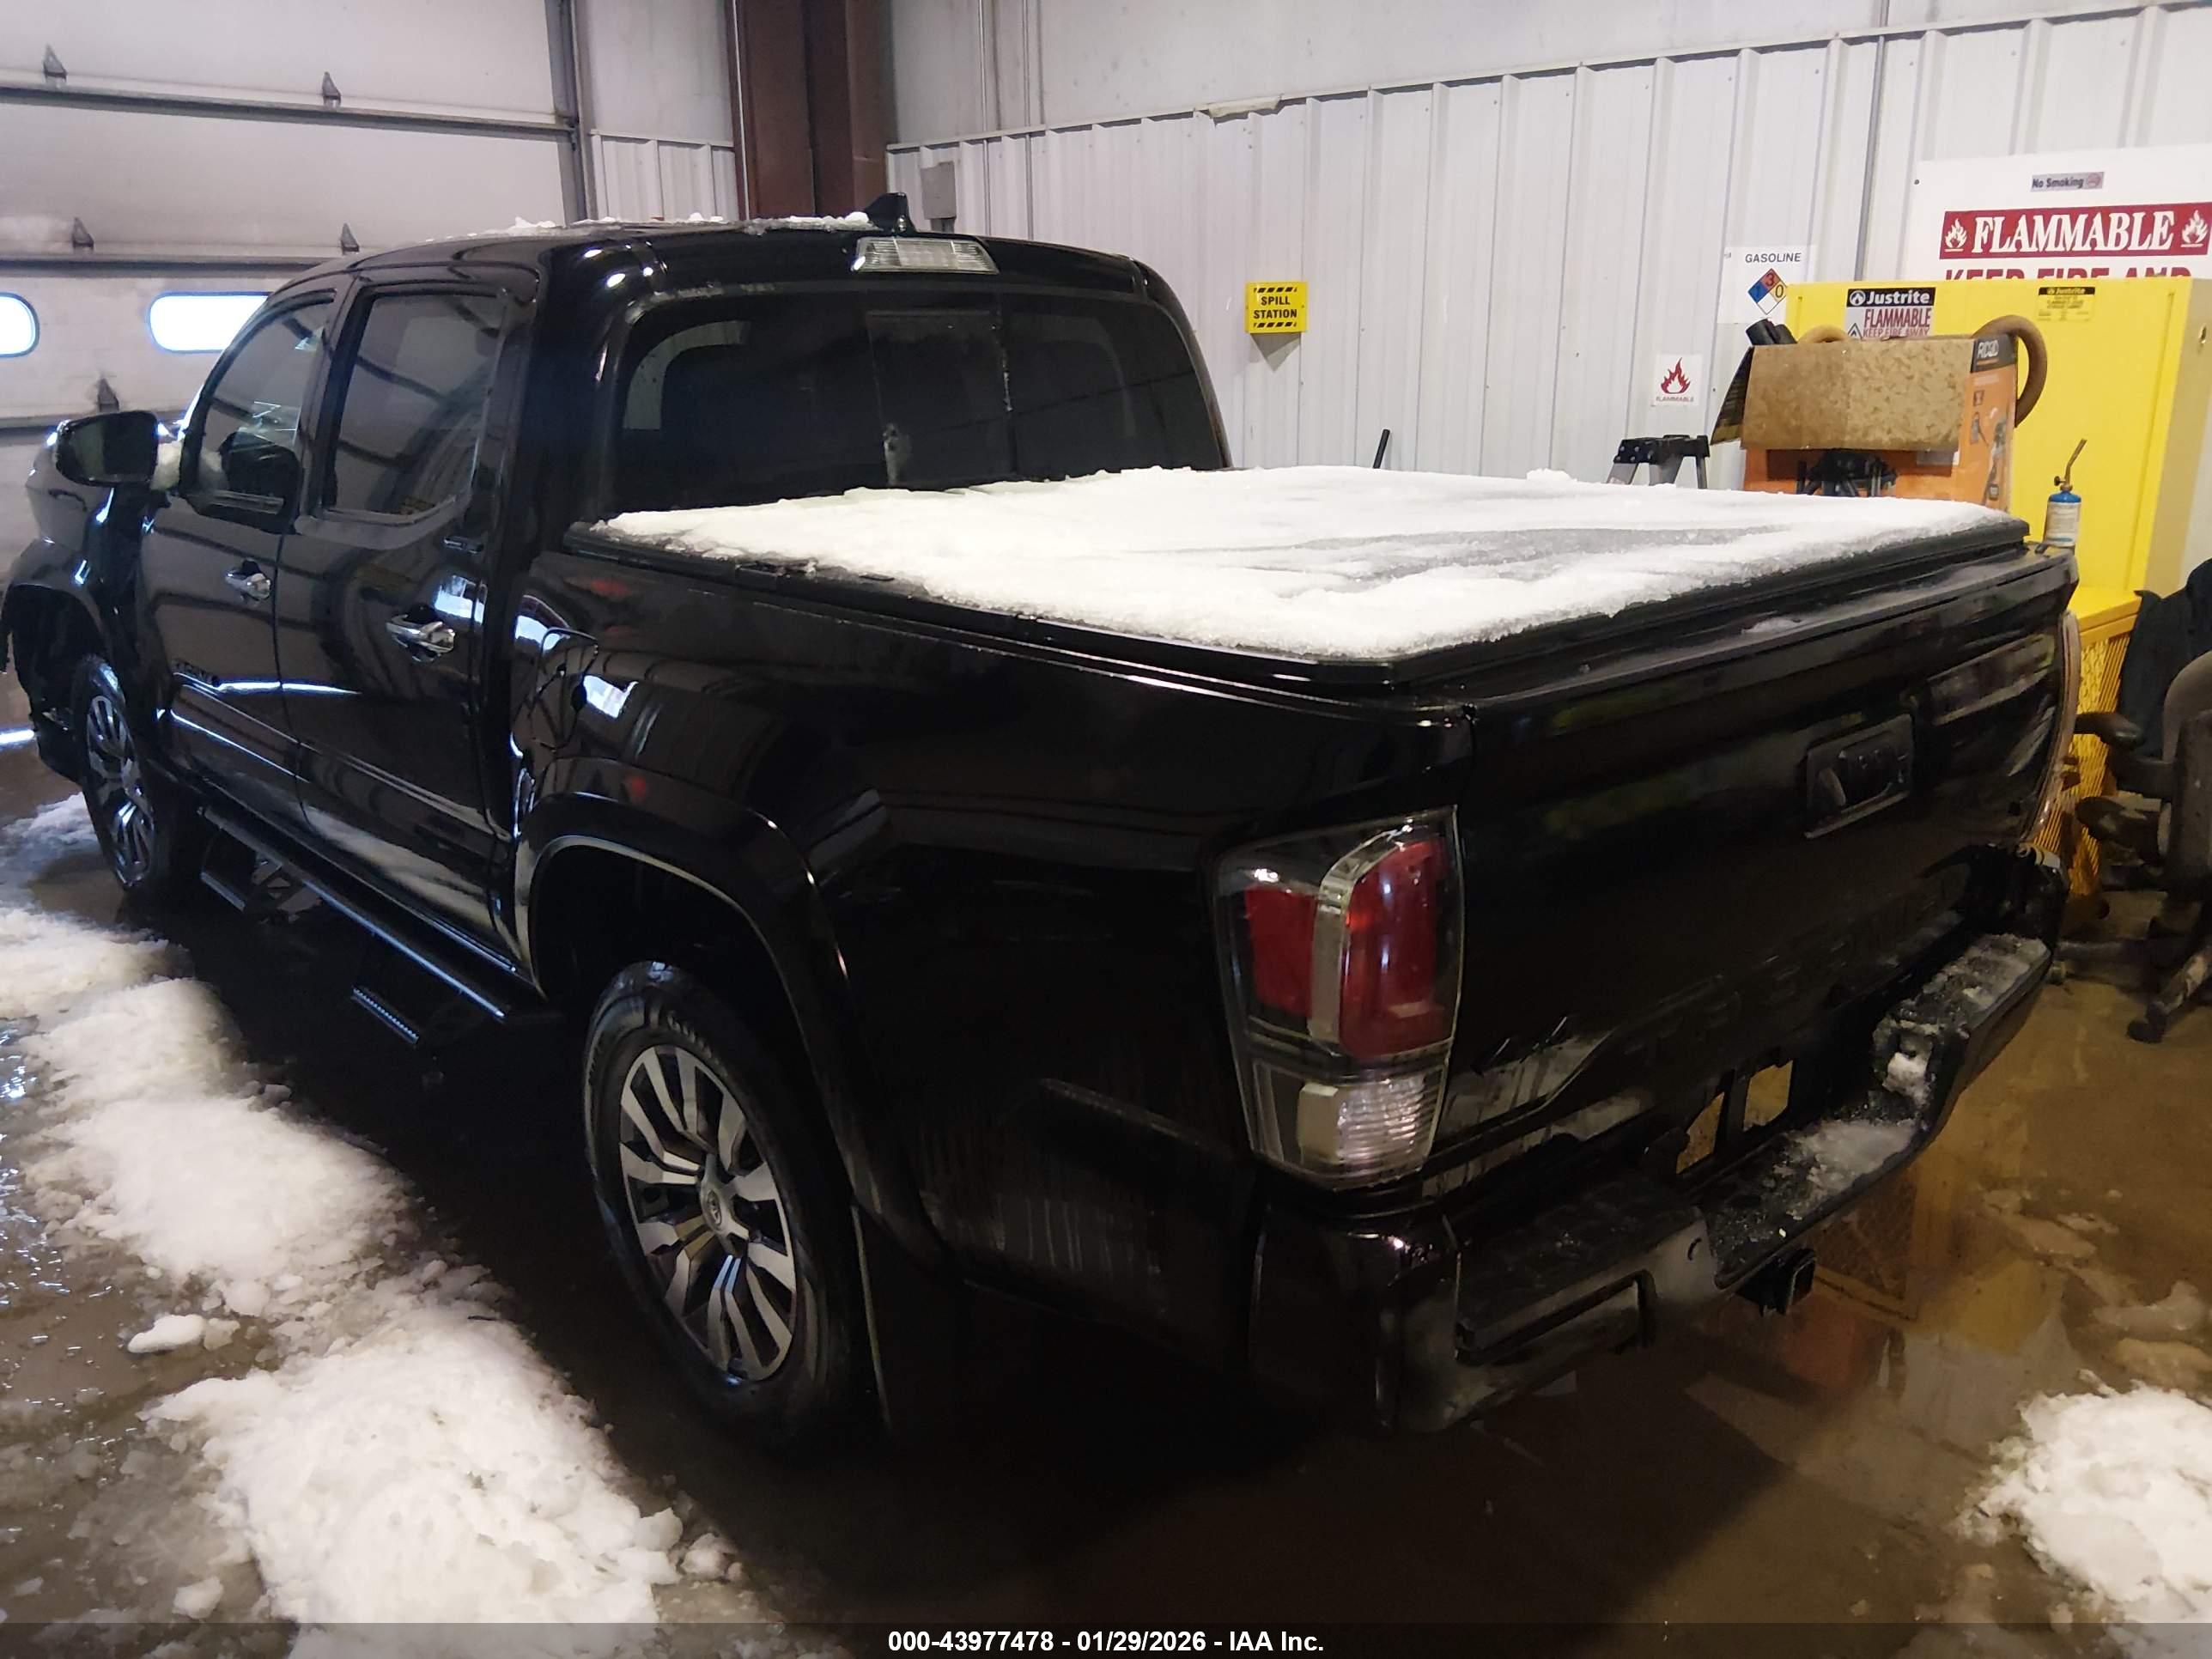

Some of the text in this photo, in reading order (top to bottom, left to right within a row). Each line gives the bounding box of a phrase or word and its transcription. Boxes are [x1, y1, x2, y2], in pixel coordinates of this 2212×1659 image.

[2032, 176, 2084, 189] No Smoking
[1972, 211, 2175, 253] FLAMMABLE
[1745, 252, 1802, 263] GASOLINE
[1765, 273, 1775, 287] 3
[1775, 284, 1784, 298] 0
[1867, 290, 1930, 304] Justrite
[1261, 296, 1291, 306] SPILL
[1254, 309, 1297, 319] STATION
[1864, 308, 1931, 327] FLAMMABLE
[1863, 327, 1884, 337] KEEP
